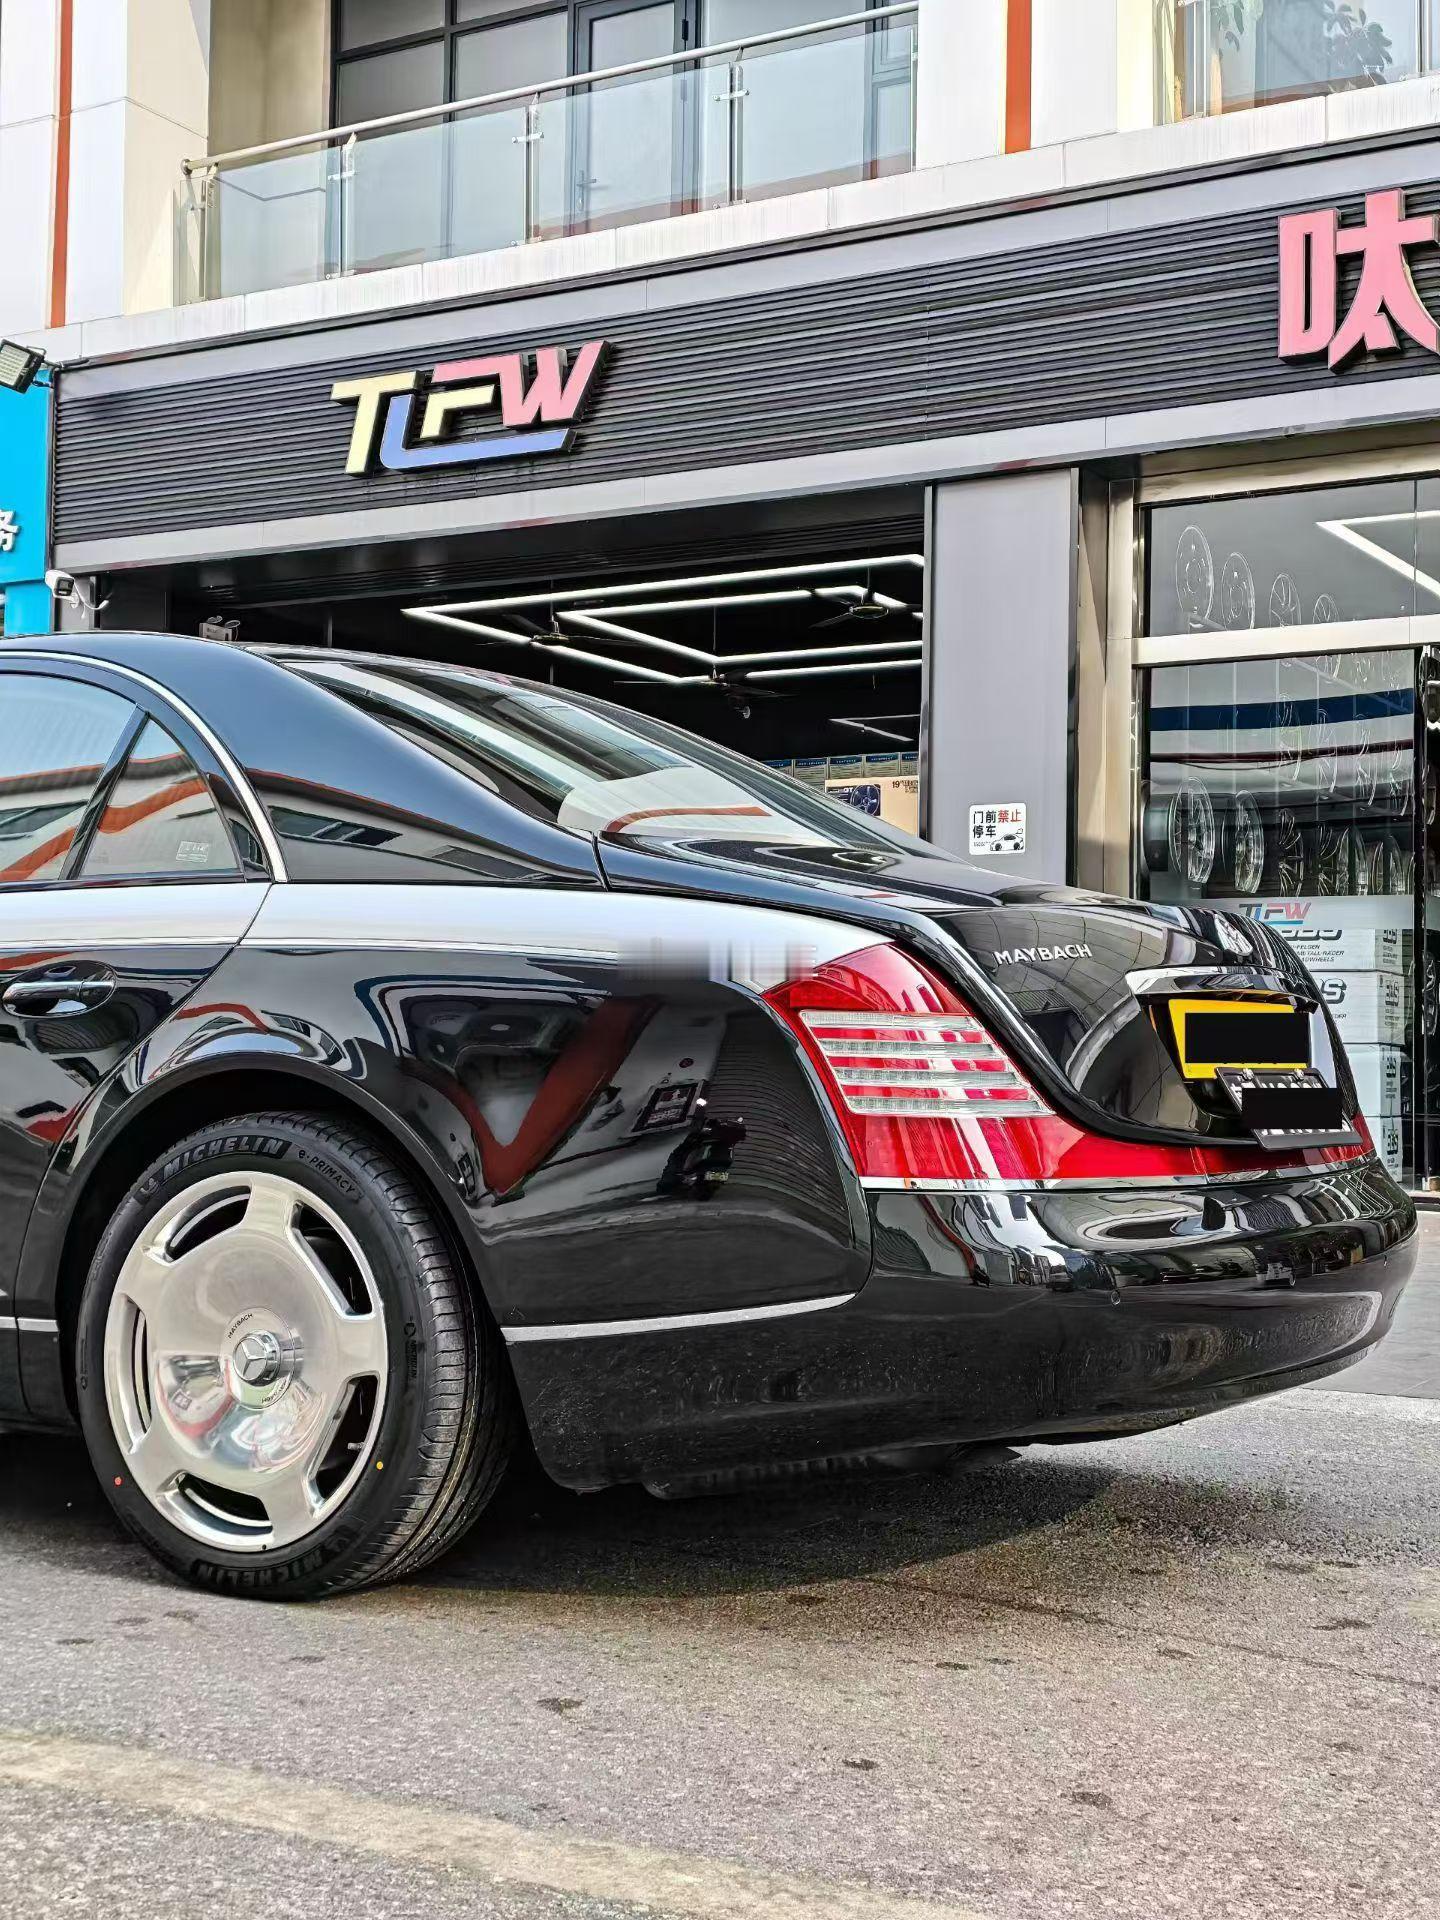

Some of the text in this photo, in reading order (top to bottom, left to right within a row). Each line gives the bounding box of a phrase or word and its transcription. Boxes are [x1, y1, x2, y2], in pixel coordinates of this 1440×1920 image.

[973, 809, 1022, 824] 门前禁止
[973, 825, 997, 838] 停车
[993, 943, 1093, 966] MAYBACH
[163, 1136, 284, 1179] MICHELIN
[227, 1313, 254, 1339] MAYBACH
